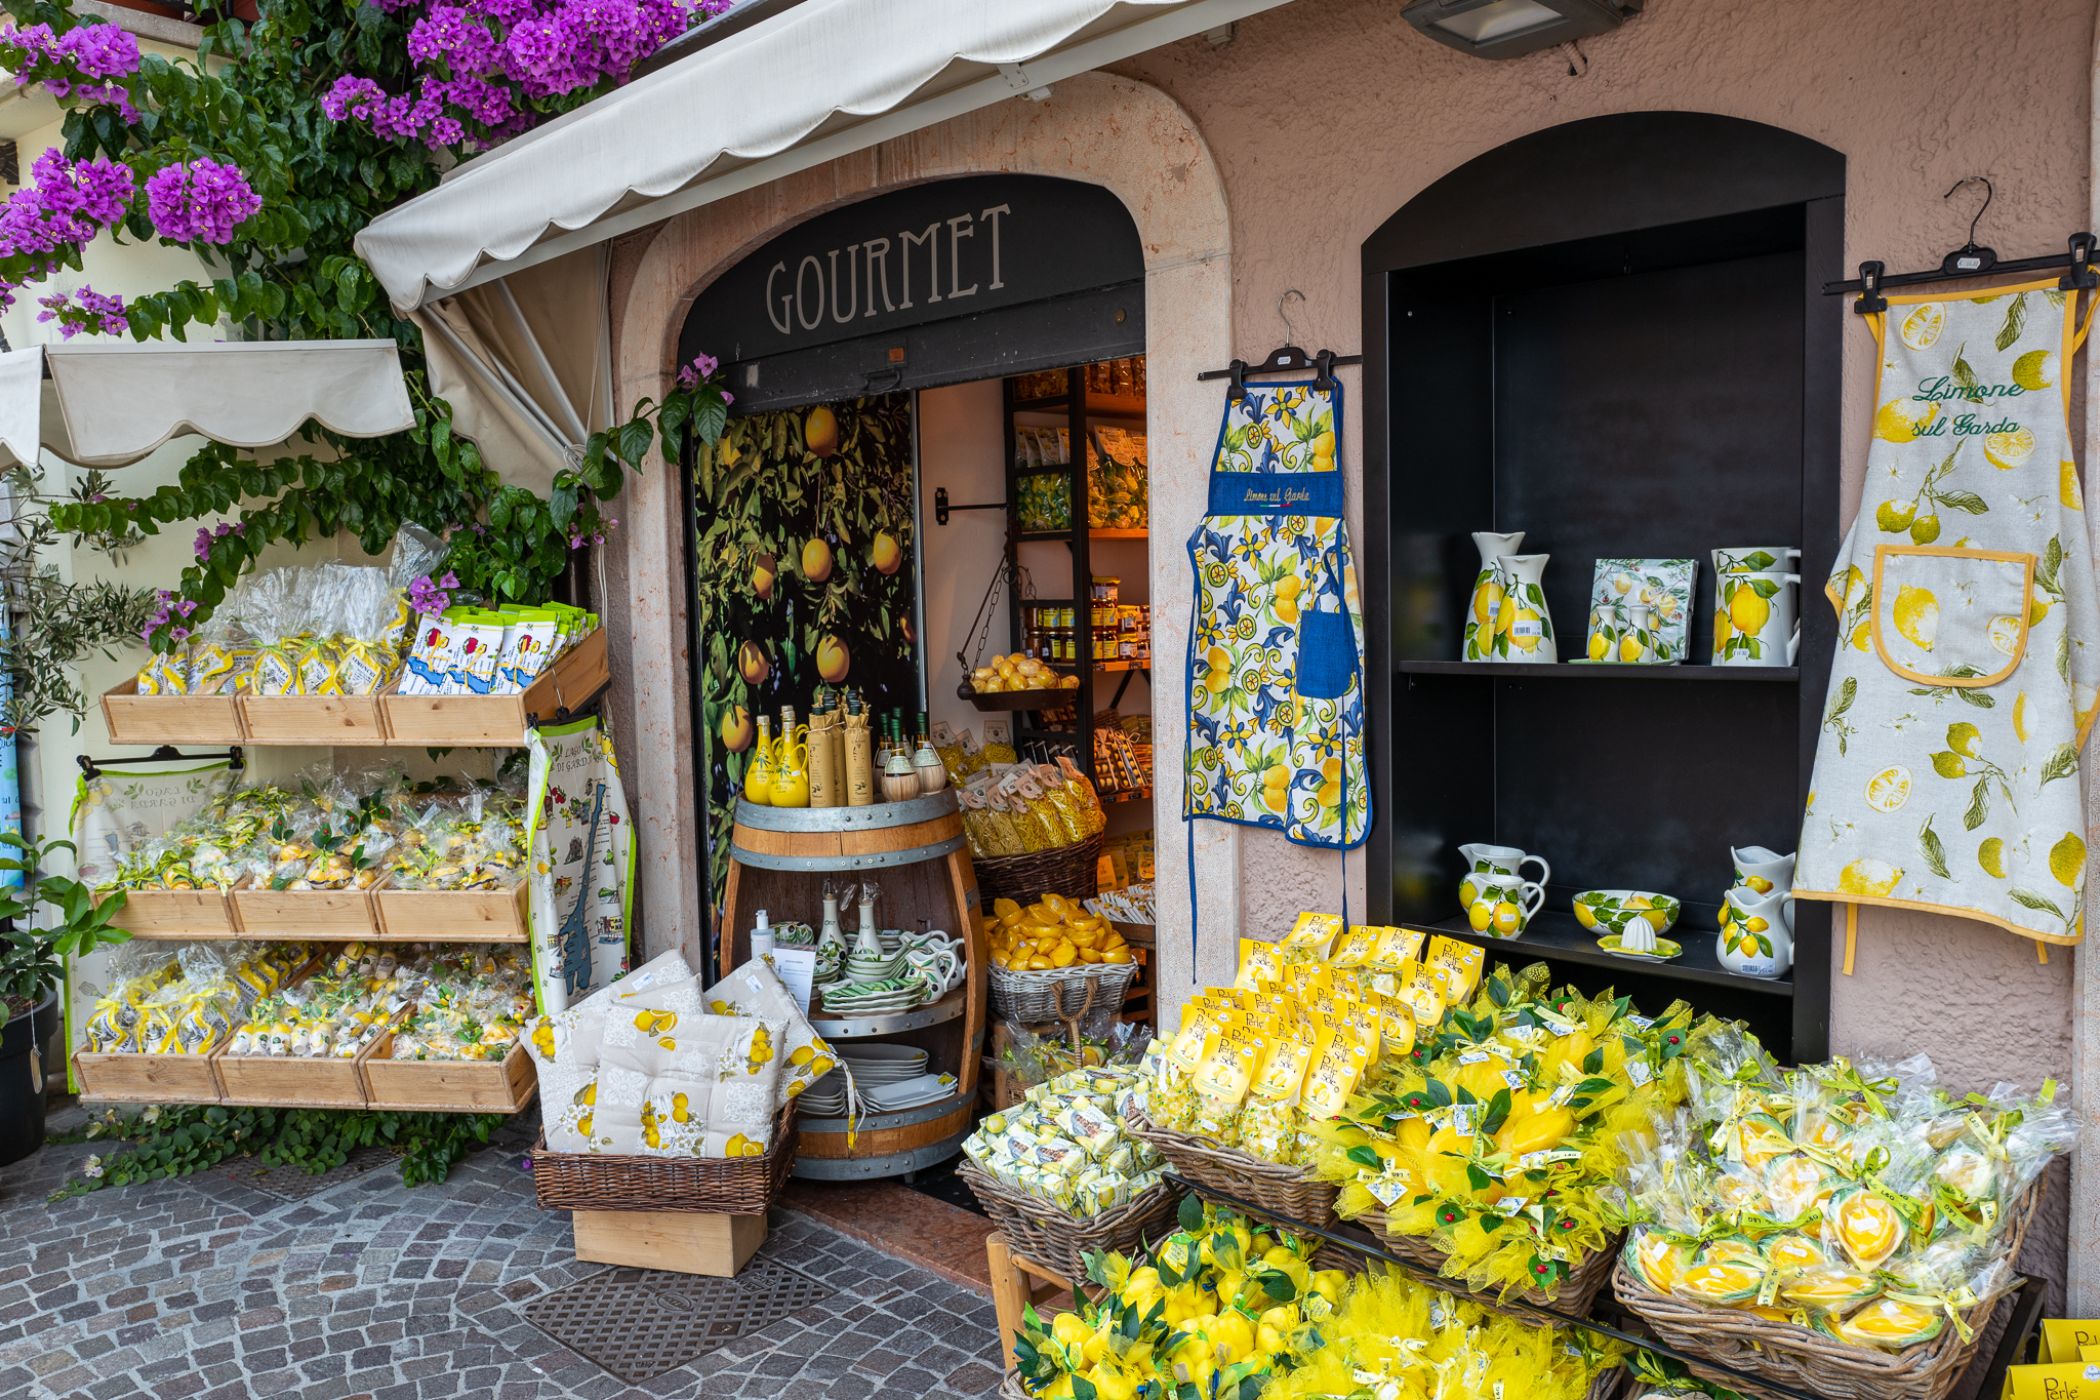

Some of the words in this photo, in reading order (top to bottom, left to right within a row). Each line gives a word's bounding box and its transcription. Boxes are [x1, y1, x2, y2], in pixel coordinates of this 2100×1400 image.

[766, 203, 1011, 335] GOURMET
[1912, 376, 2026, 402] Limone
[1912, 416, 1948, 437] sul
[1952, 413, 2020, 436] Garda
